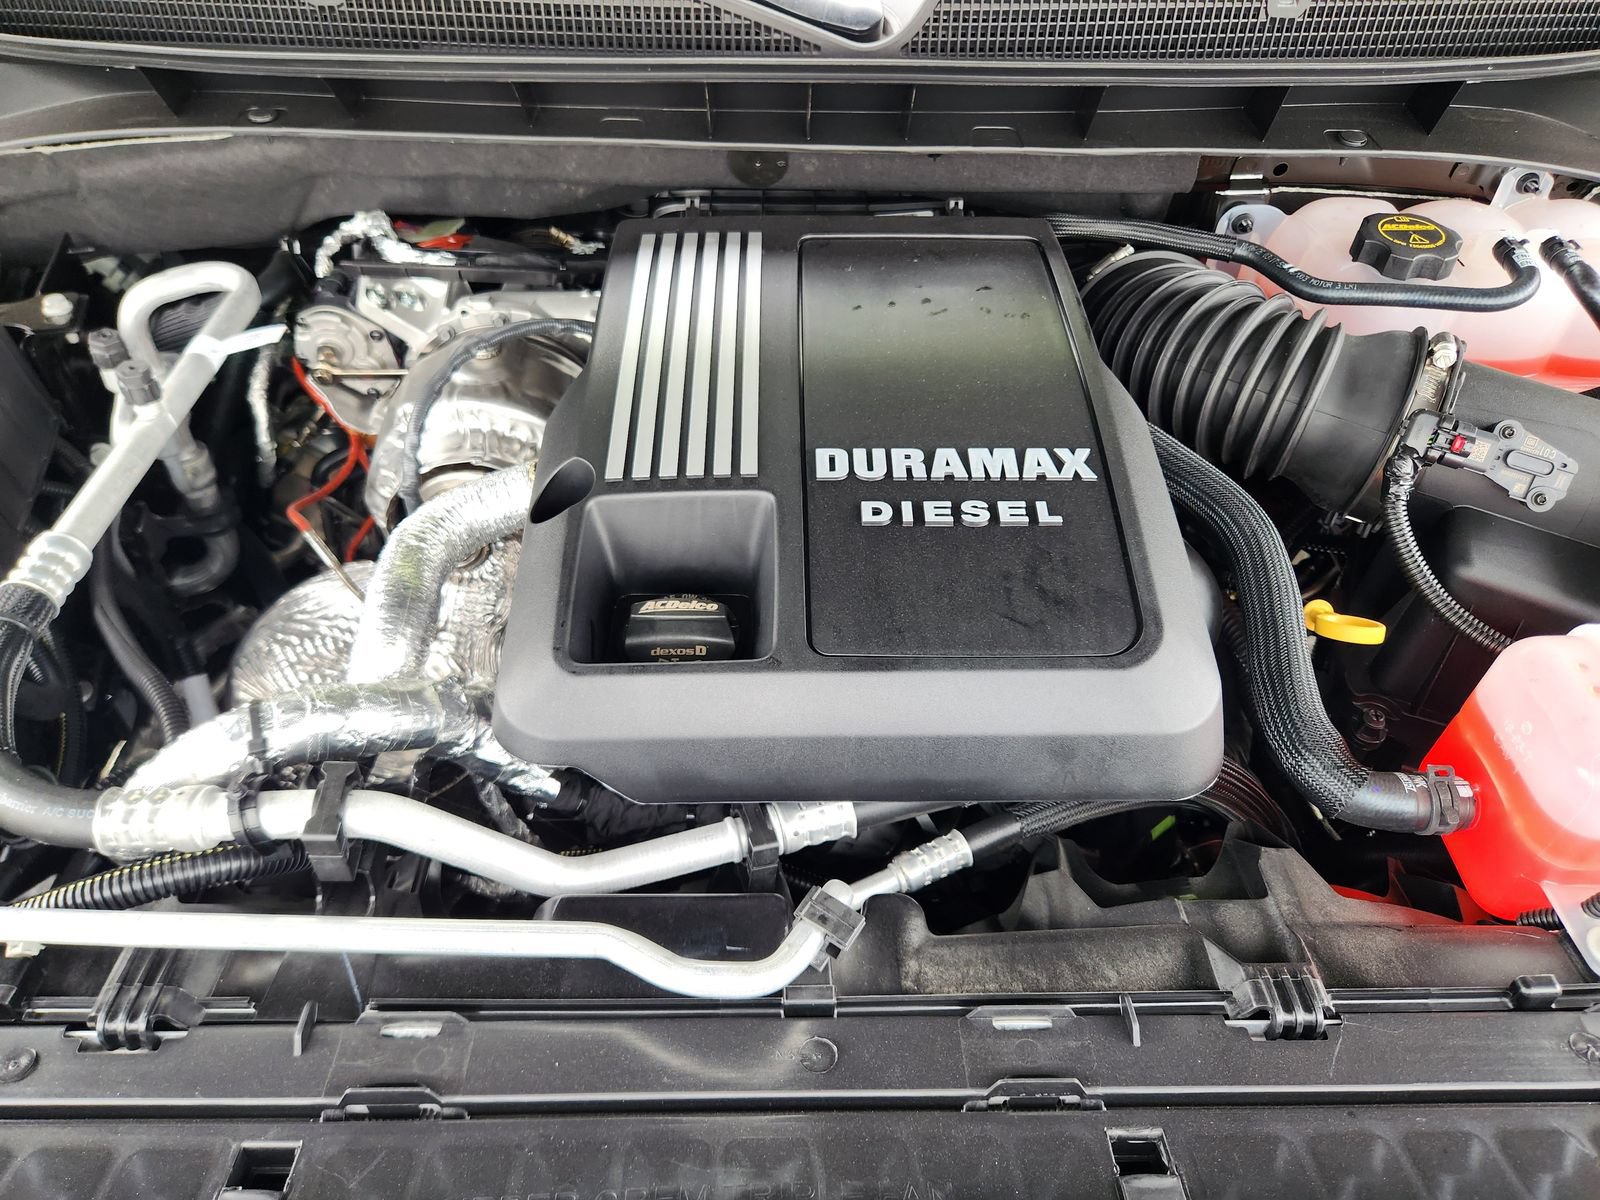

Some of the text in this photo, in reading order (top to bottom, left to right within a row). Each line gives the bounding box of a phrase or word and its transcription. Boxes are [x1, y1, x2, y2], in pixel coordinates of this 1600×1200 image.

[815, 448, 1099, 481] DURAMAX
[861, 500, 1064, 527] DIESEL
[639, 600, 720, 613] ACDelco
